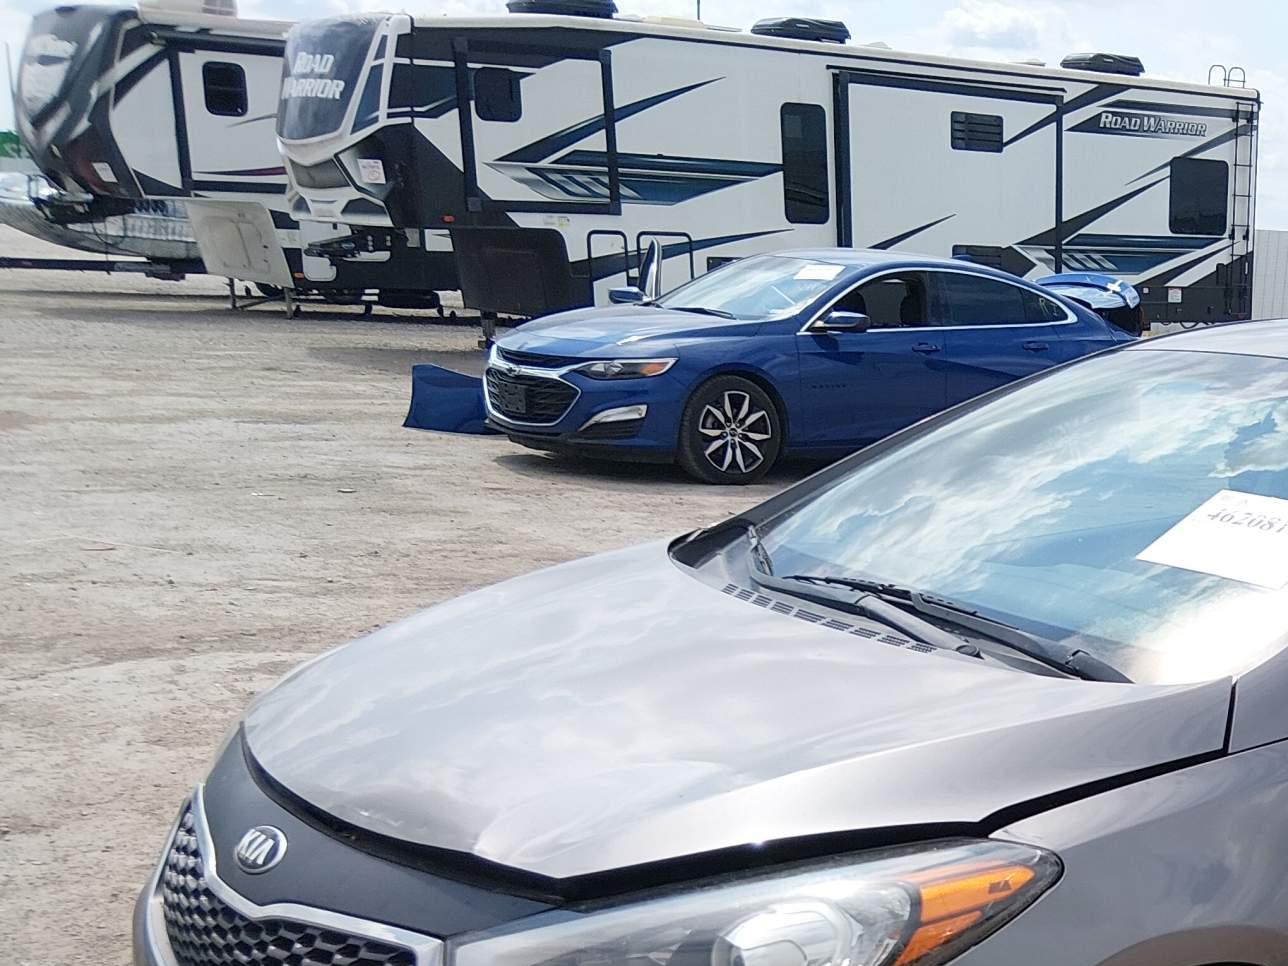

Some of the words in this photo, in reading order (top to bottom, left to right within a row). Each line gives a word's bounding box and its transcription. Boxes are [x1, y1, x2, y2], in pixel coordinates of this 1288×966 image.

[293, 51, 335, 75] ROAD
[1099, 112, 1140, 131] ROAD
[1143, 115, 1208, 136] WARRIOR
[237, 827, 278, 867] KIA
